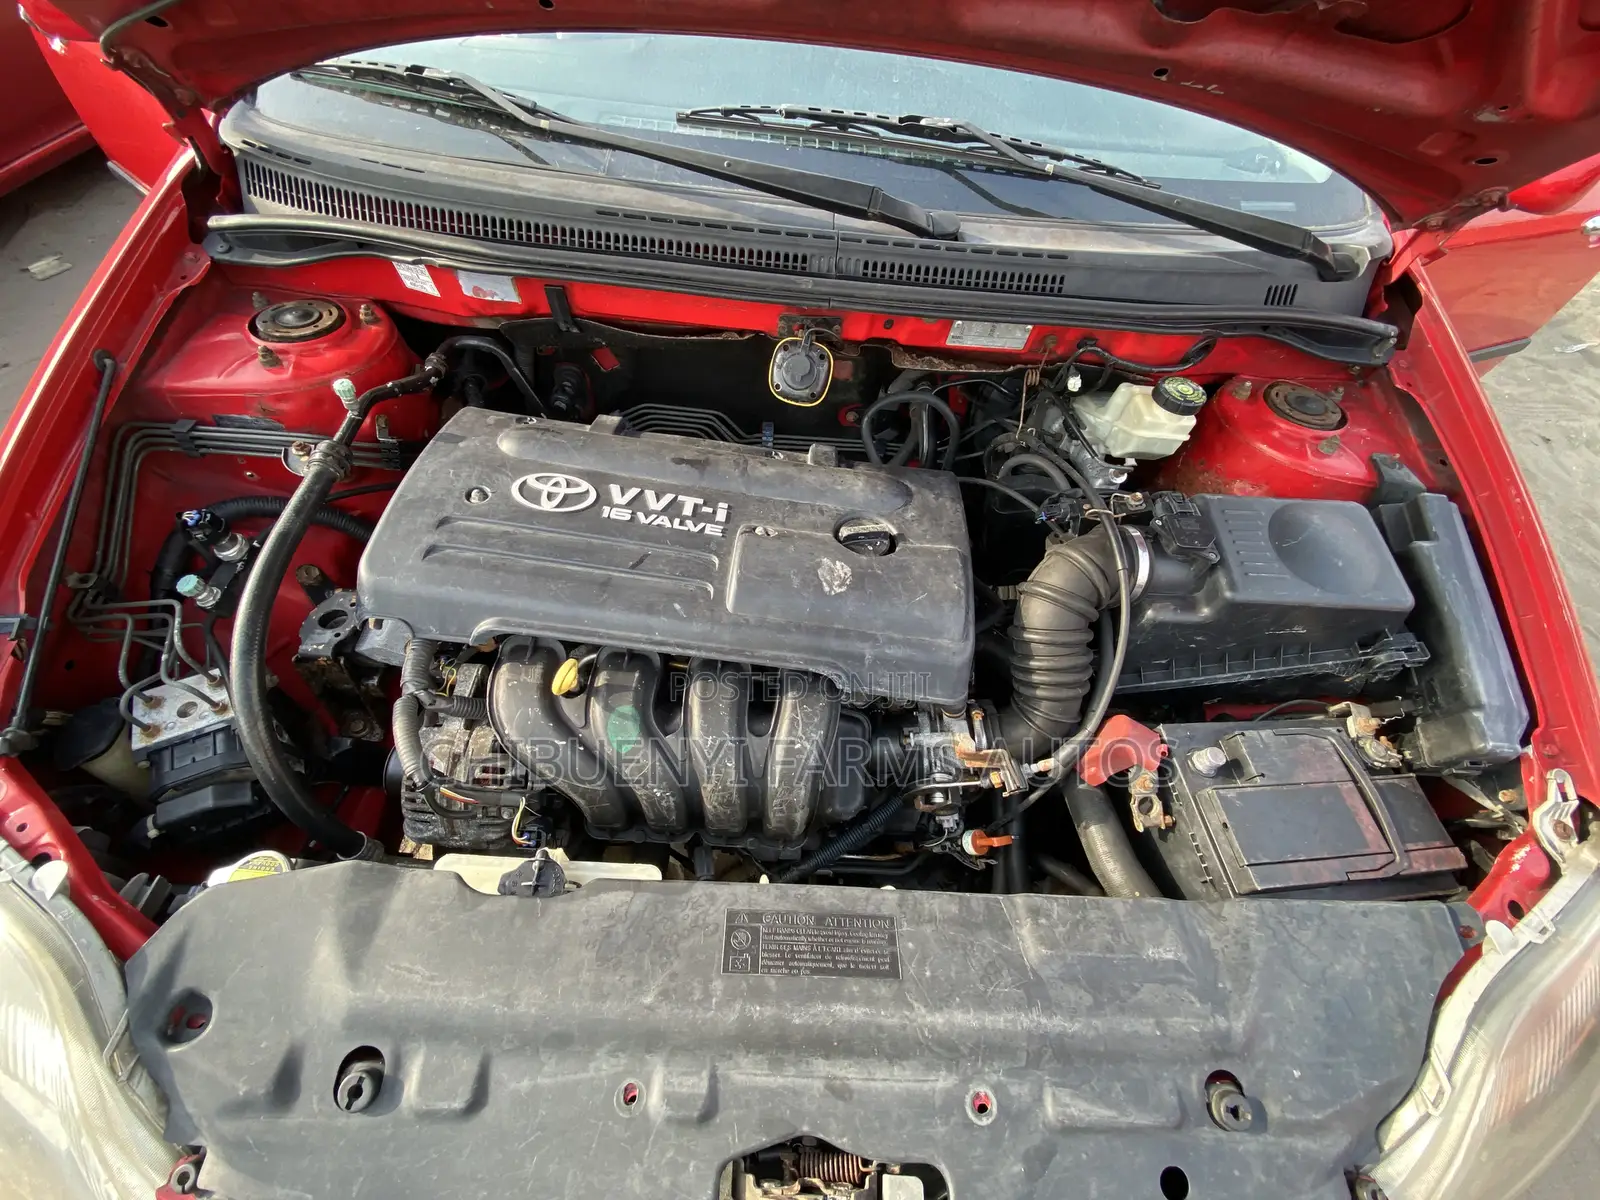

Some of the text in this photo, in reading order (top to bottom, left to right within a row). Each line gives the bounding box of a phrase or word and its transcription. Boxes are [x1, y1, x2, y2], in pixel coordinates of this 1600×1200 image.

[609, 483, 729, 522] VVT-i
[602, 505, 725, 537] 16 VALVE
[762, 912, 890, 929] CAUTION ATTENTION
